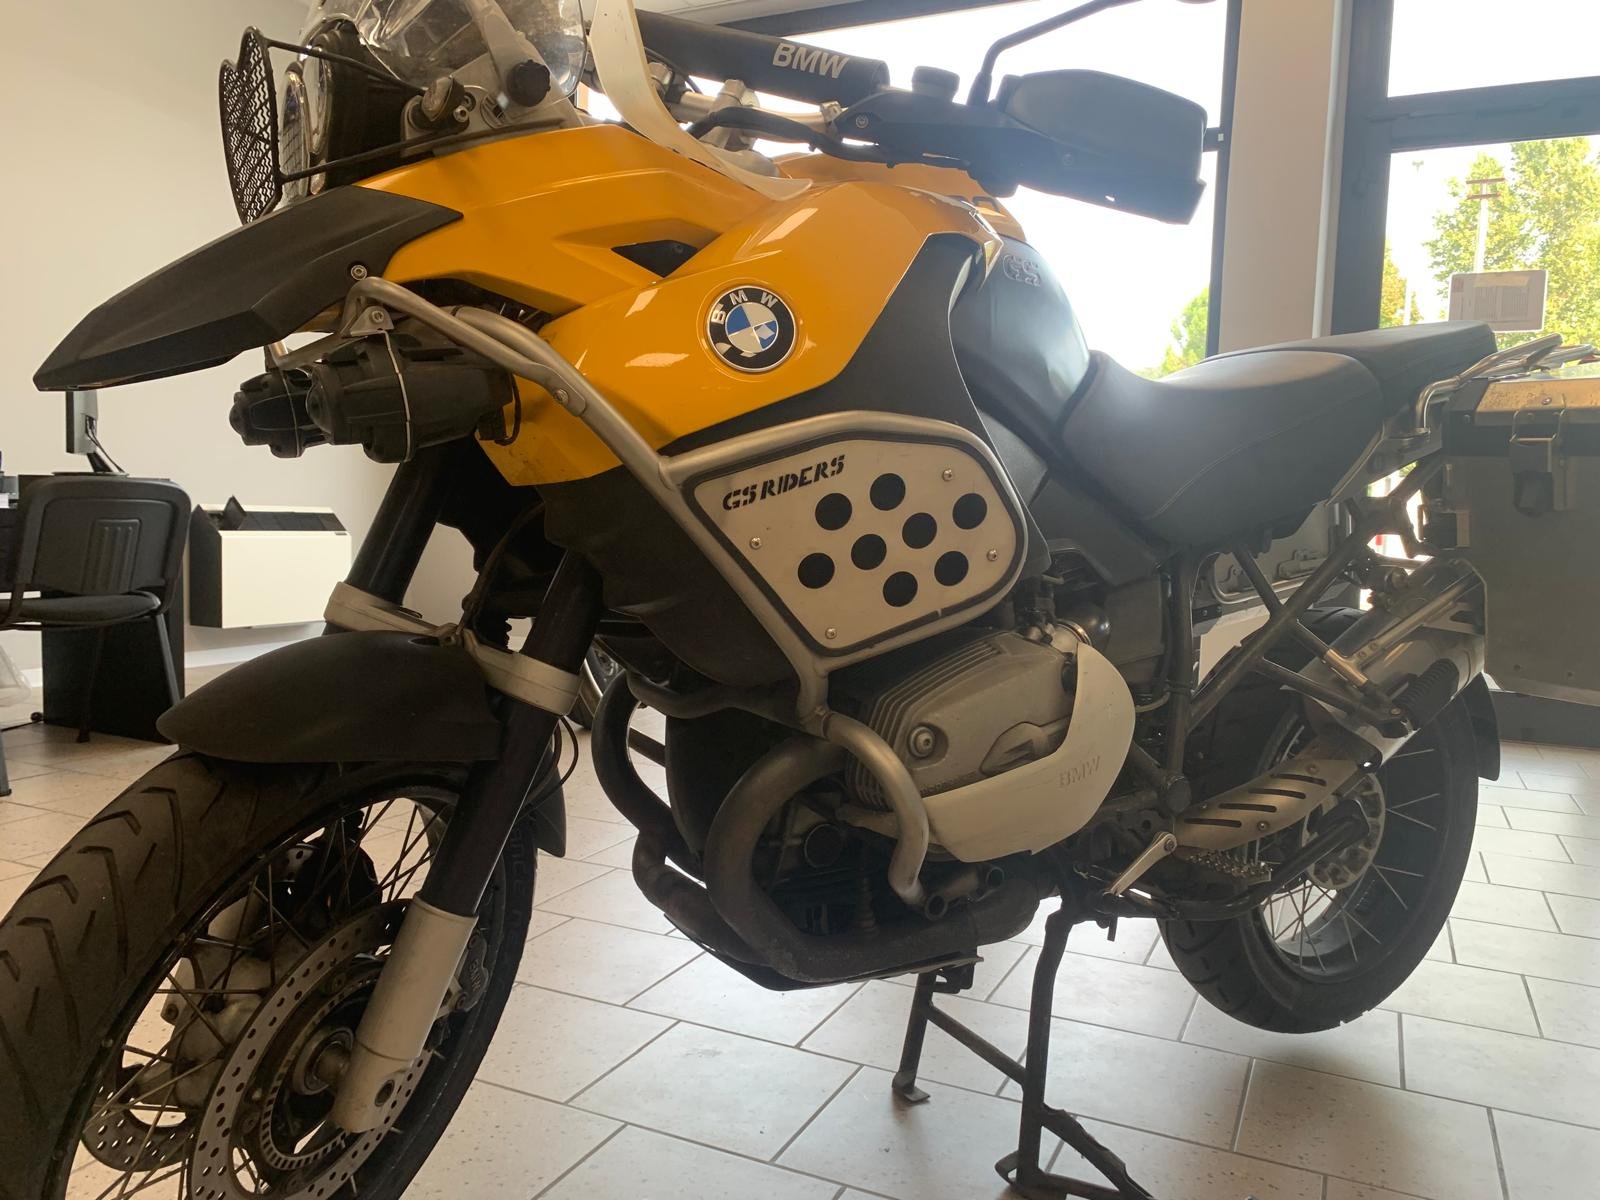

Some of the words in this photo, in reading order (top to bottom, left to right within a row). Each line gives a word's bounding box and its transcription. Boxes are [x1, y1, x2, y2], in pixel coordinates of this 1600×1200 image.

[773, 42, 850, 79] BMW
[1003, 254, 1041, 288] GS
[711, 289, 779, 325] BMW
[722, 483, 757, 511] GS
[760, 454, 845, 500] RIDERS
[1059, 755, 1101, 788] BMW
